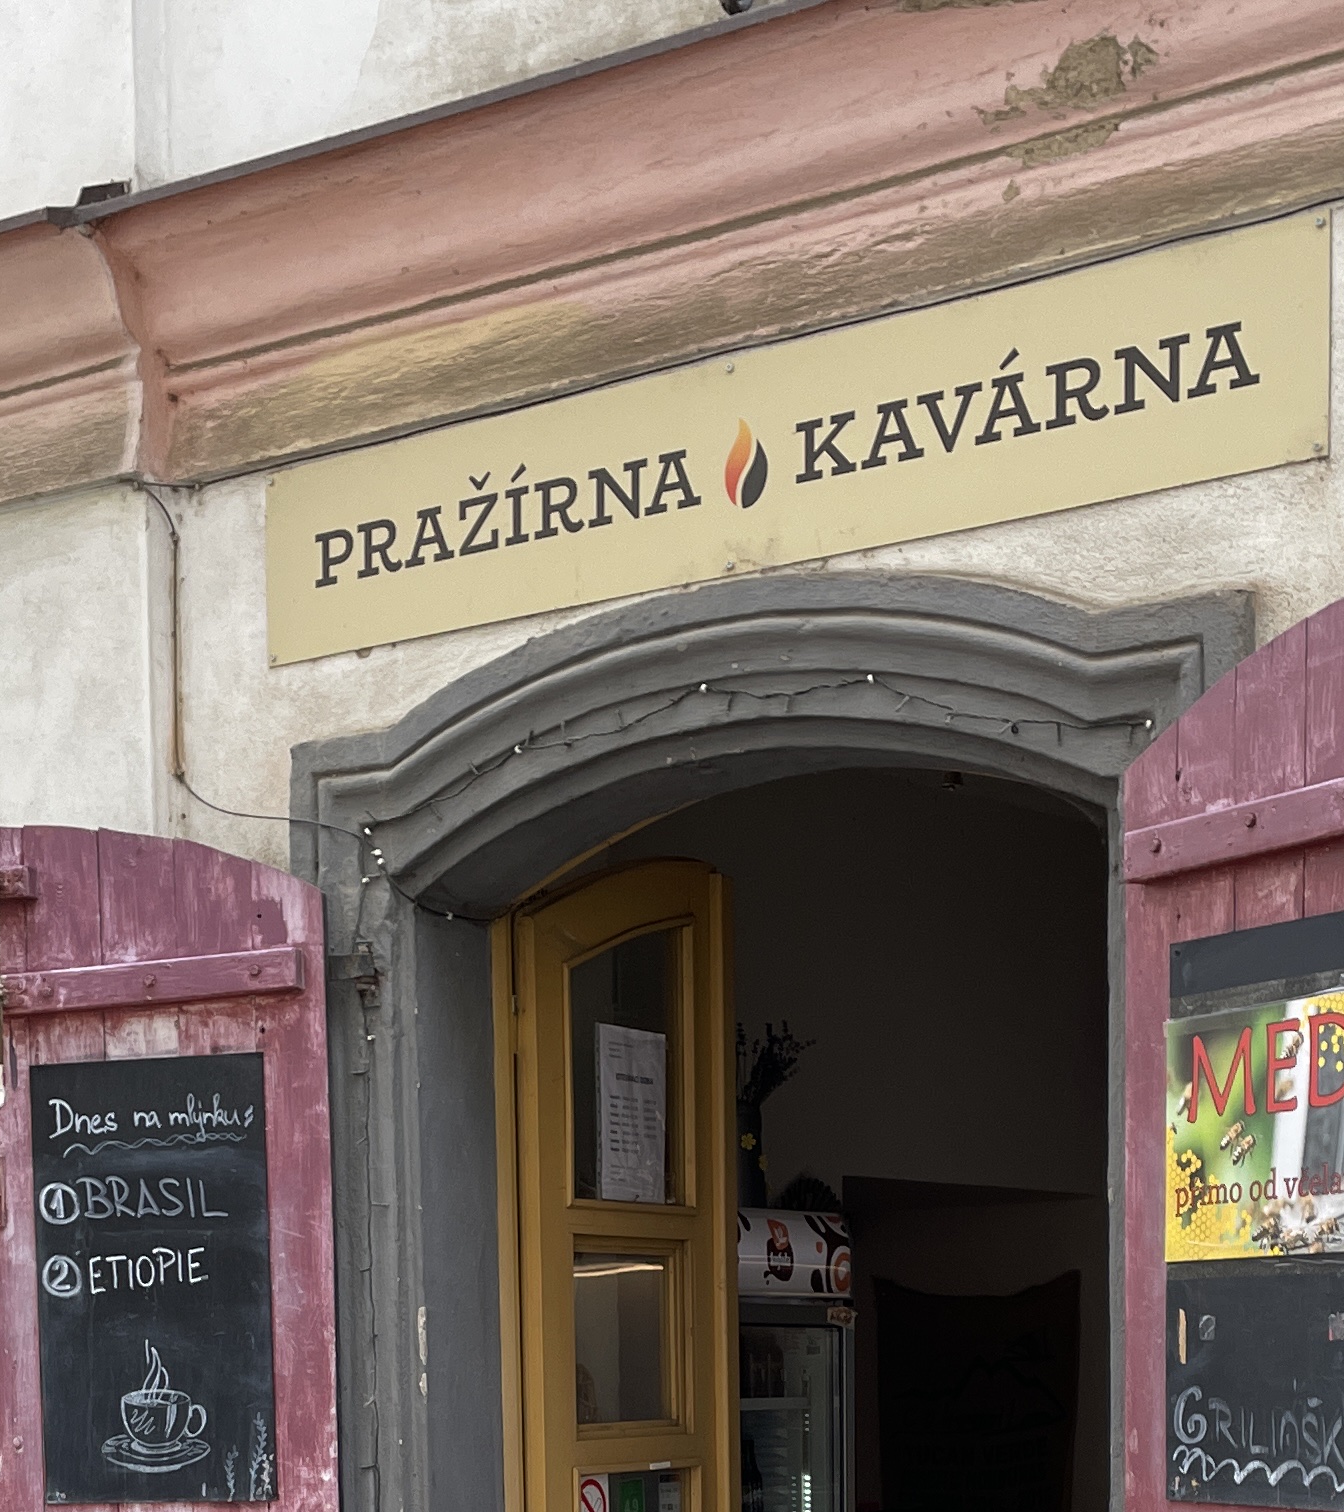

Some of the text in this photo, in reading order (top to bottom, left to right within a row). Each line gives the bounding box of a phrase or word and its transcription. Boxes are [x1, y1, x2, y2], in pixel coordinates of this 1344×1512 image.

[313, 320, 1260, 588] PRAŽÍRNA KAVÁRNA
[49, 1098, 118, 1139] Dnes
[133, 1110, 161, 1129] na
[76, 1175, 229, 1219] BRASIL
[1250, 1167, 1277, 1201] od
[88, 1246, 209, 1295] ETIOPIE
